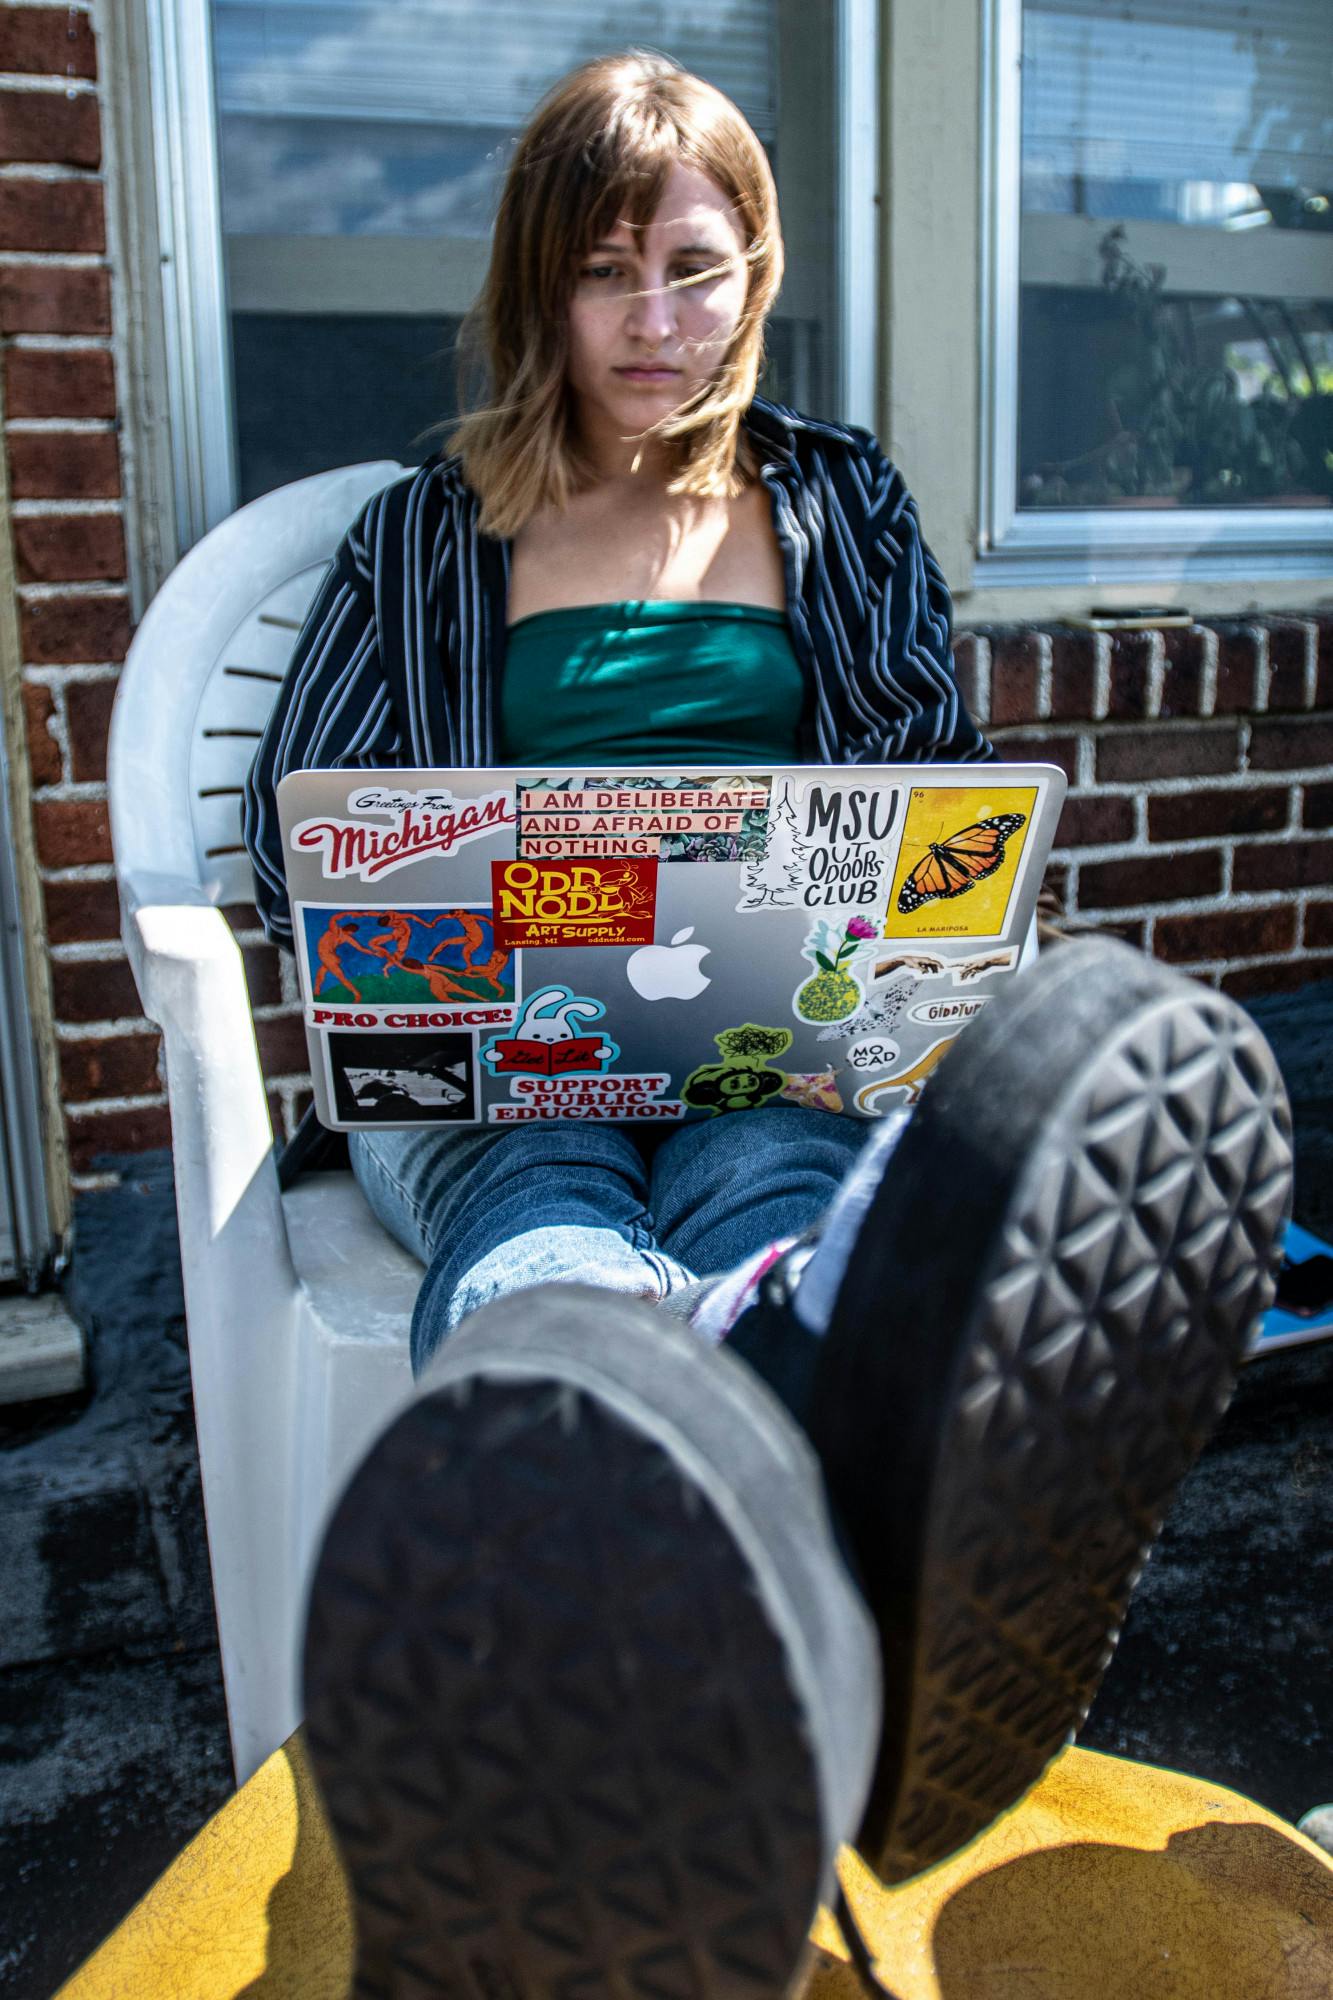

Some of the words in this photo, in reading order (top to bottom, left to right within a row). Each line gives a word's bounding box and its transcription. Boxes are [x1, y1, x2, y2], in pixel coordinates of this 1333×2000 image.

[355, 793, 418, 813] Greetings
[419, 796, 454, 810] From
[524, 793, 531, 808] I
[543, 793, 583, 808] AM
[596, 790, 766, 808] DELIBERATE
[524, 817, 581, 832] AND
[592, 816, 692, 832] AFRAID
[704, 815, 739, 830] OF
[805, 787, 899, 844] MSU
[298, 797, 517, 876] Michigan
[524, 839, 657, 855] NOTHING.
[504, 862, 603, 896] ODD
[803, 880, 878, 906] CLUB
[498, 889, 624, 919] NODD
[313, 1010, 378, 1028] PRO
[384, 1009, 513, 1028] CHOICE!
[853, 1045, 884, 1058] MO
[853, 1052, 896, 1068] CAD
[517, 1078, 664, 1094] SUPPORT
[532, 1092, 648, 1107] PUBLIC
[495, 1104, 682, 1121] EDUCATION
